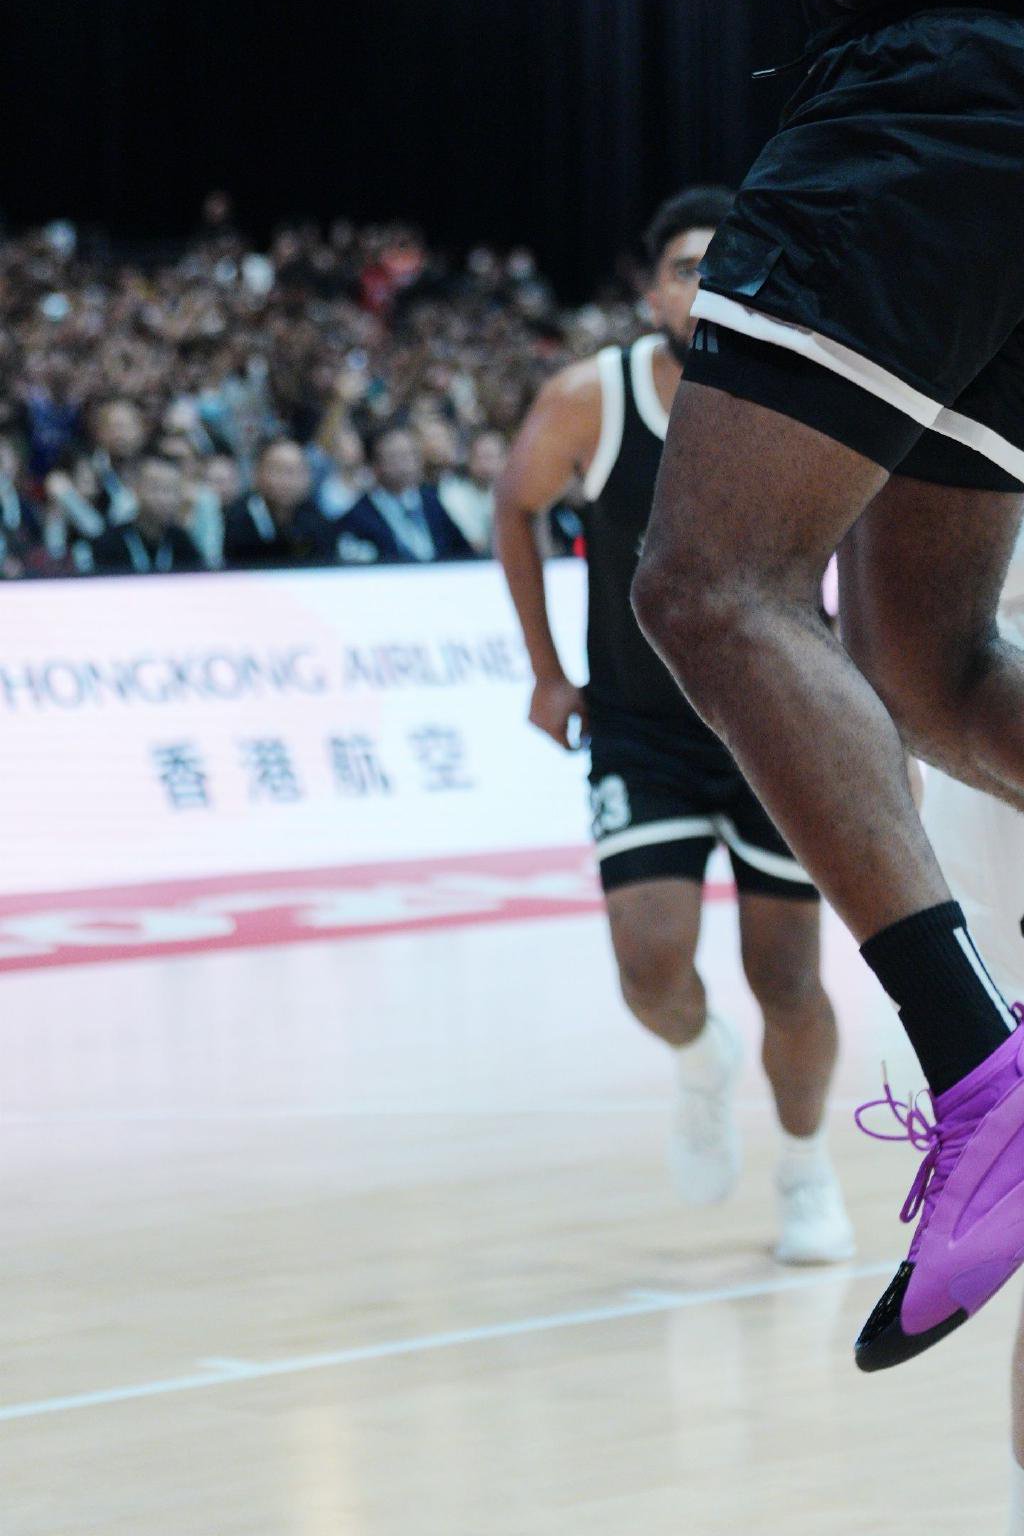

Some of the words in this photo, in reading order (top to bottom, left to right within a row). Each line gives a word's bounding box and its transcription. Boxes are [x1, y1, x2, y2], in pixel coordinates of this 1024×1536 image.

[0, 645, 327, 709] HONGKONG
[152, 724, 473, 811] 香港航空
